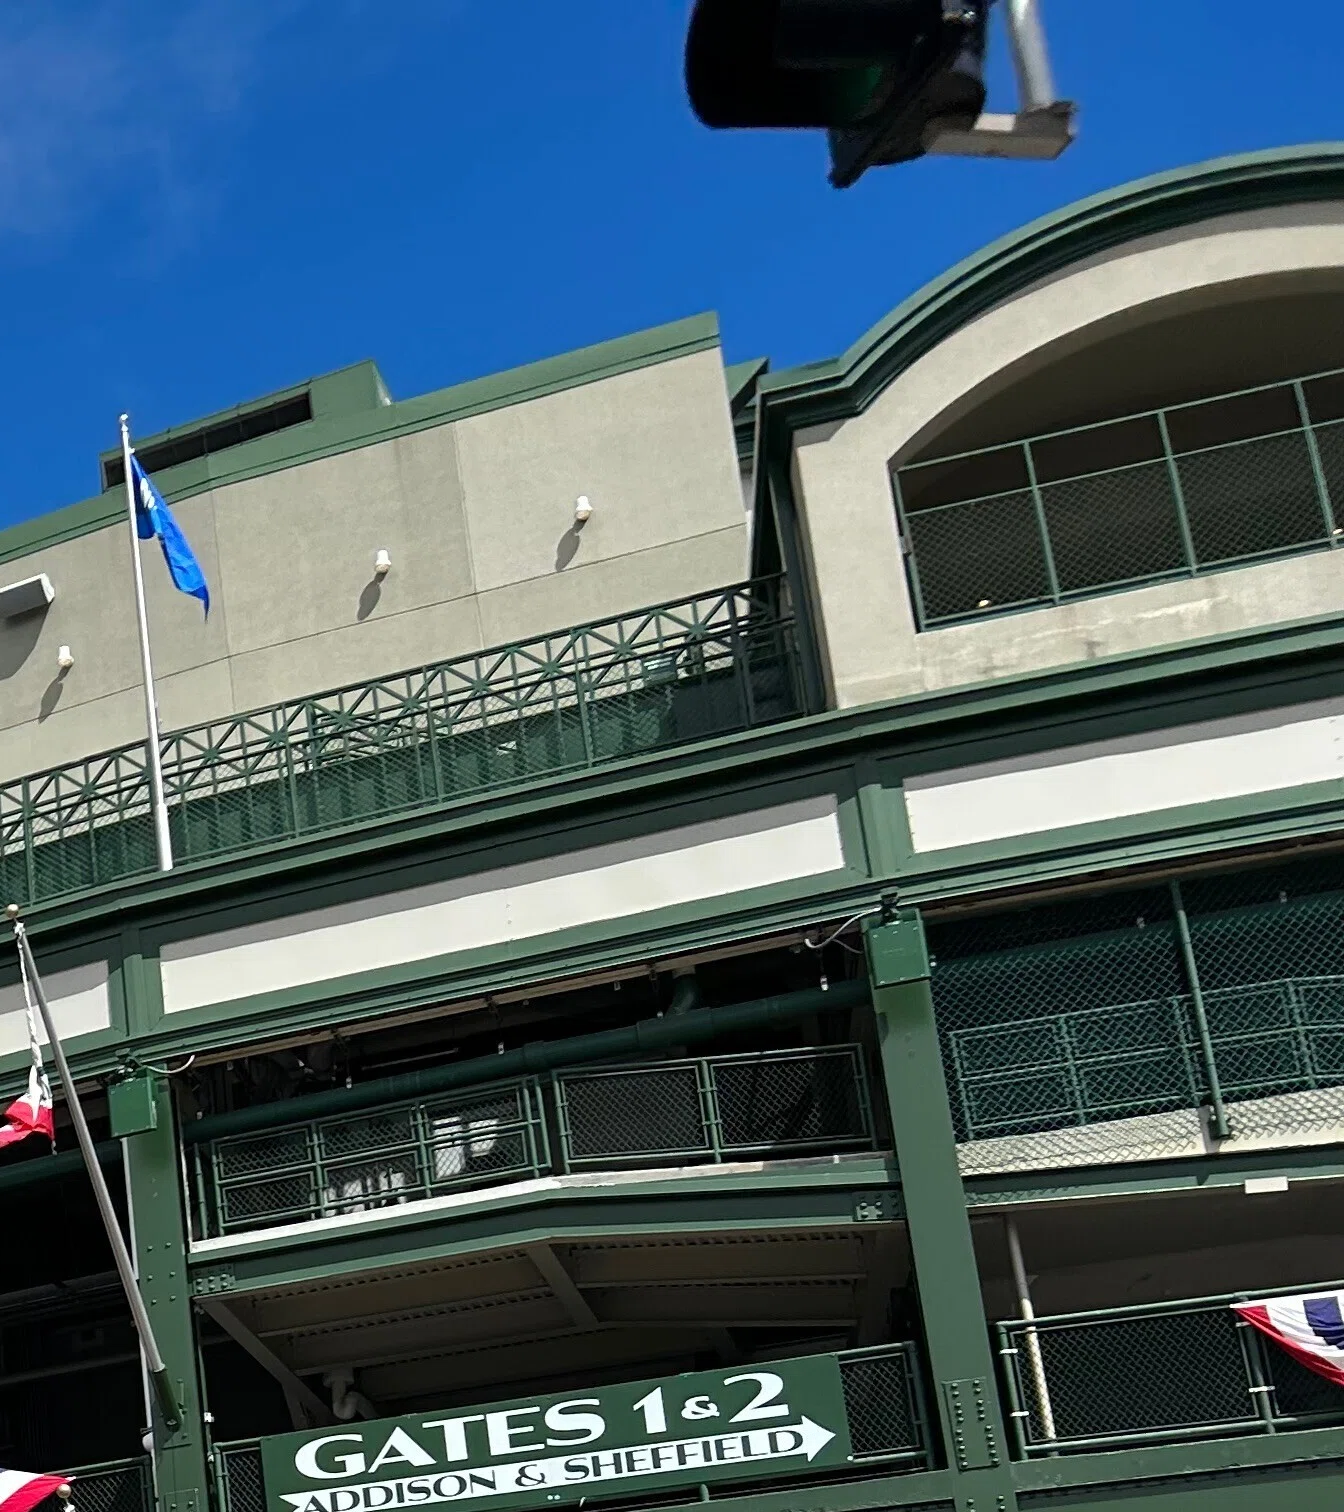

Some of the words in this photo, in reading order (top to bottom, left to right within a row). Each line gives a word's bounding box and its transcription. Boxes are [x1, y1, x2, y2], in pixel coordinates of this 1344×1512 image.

[294, 1397, 606, 1480] GATES
[515, 1463, 546, 1488] &
[563, 1430, 805, 1481] SHEFFIELD
